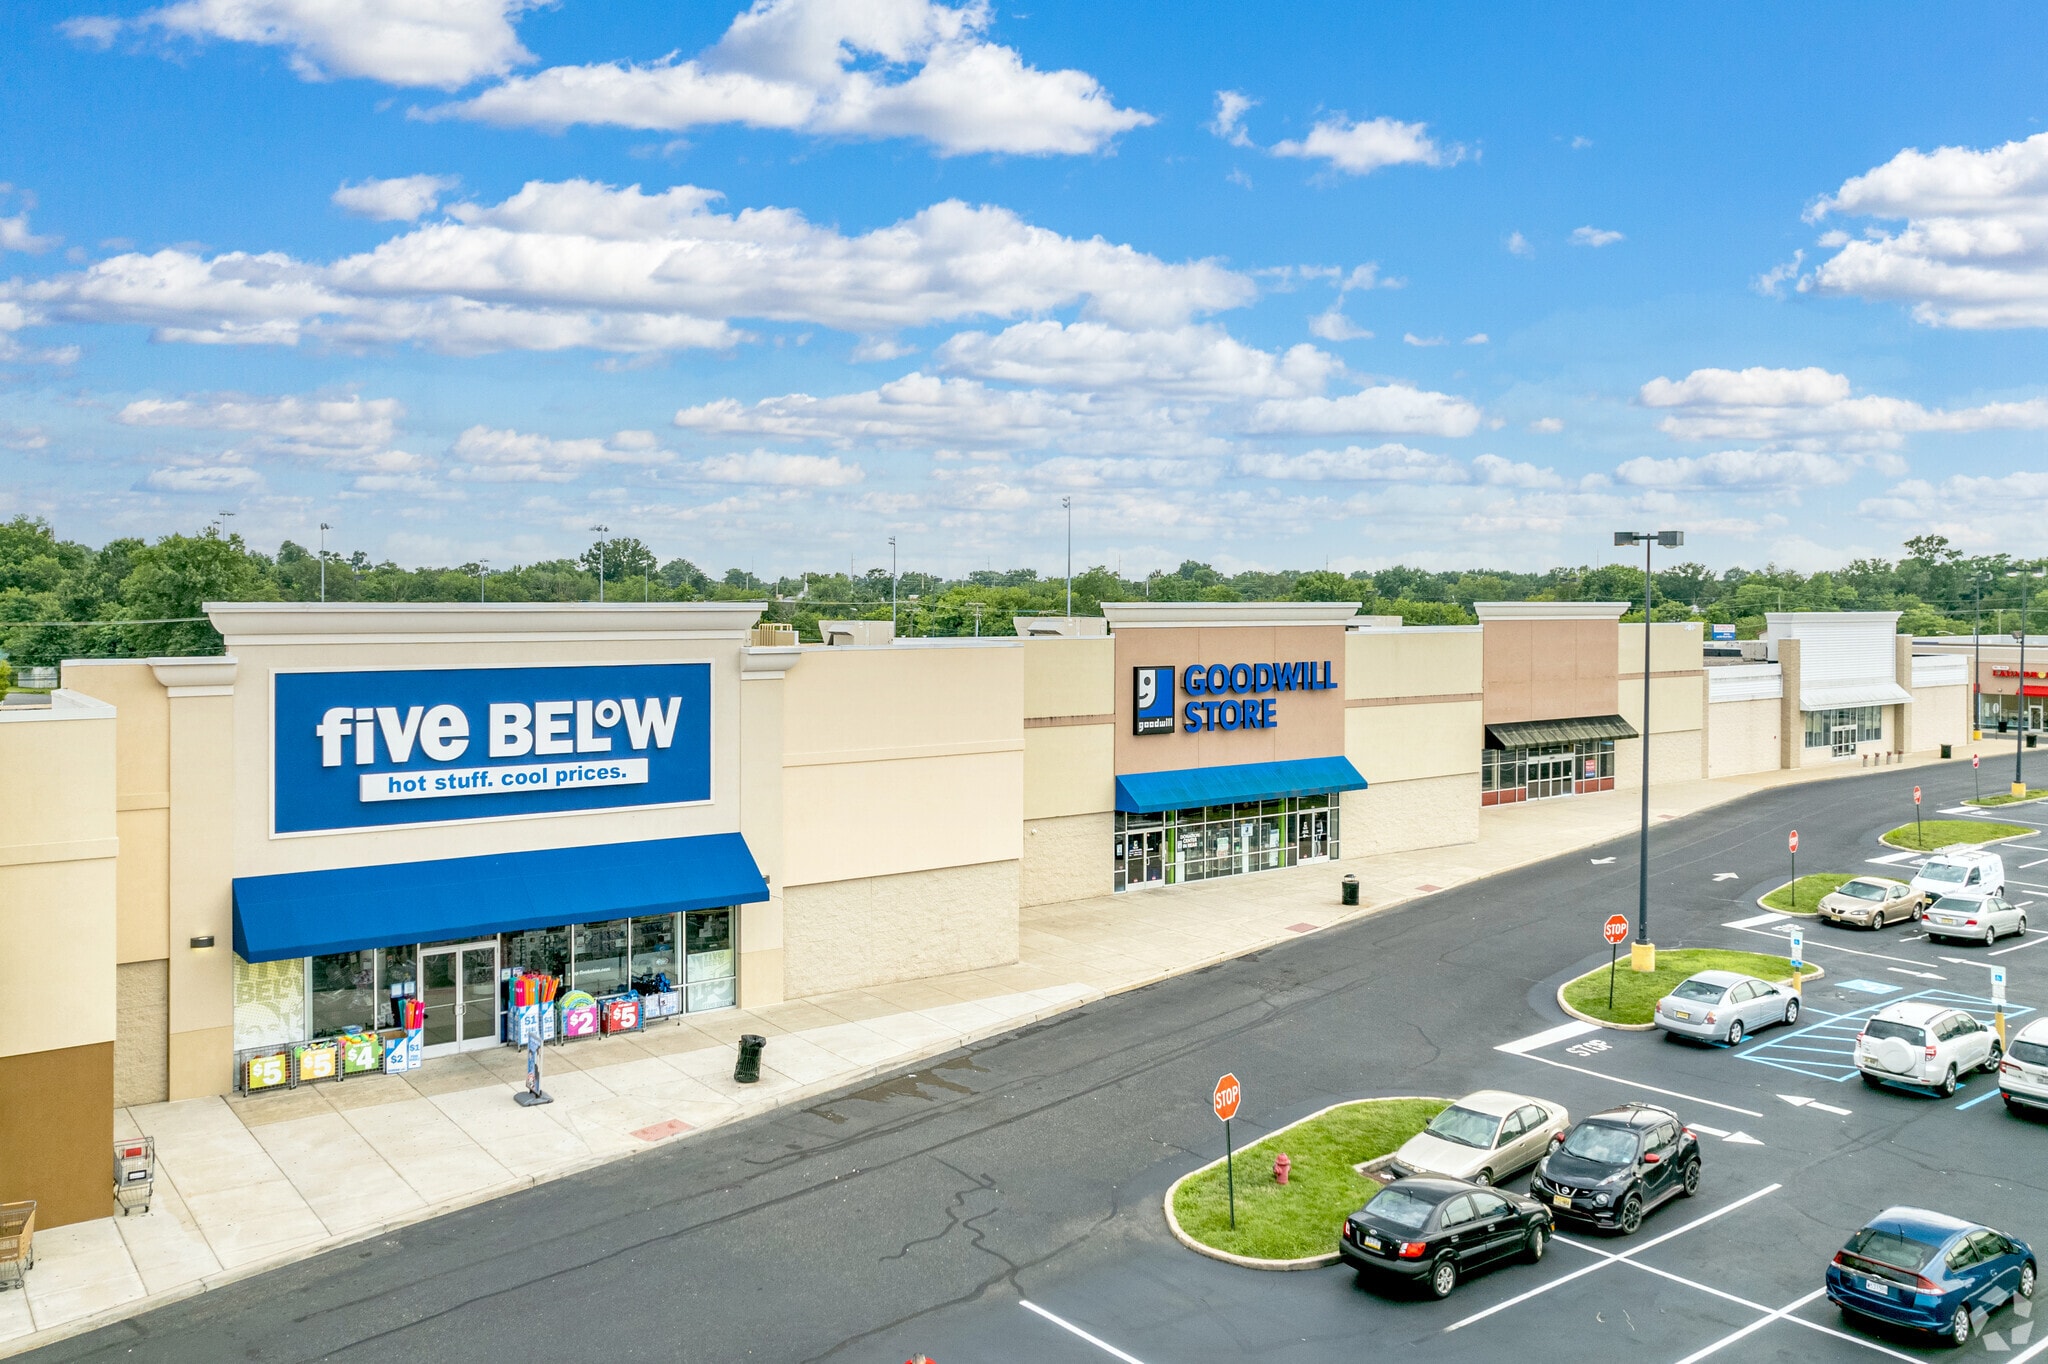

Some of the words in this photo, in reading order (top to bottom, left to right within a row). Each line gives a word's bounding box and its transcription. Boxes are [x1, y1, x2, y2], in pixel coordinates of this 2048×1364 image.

[1184, 660, 1338, 696] GOODWILL
[1138, 717, 1173, 732] goodwill
[1184, 698, 1278, 733] STORE
[489, 697, 683, 757] BELOW
[388, 775, 427, 793] hot
[434, 771, 493, 790] stuff.
[501, 768, 547, 786] cool
[556, 765, 627, 786] prices.
[1606, 923, 1627, 936] STOP
[524, 1014, 537, 1026] $1
[569, 1012, 594, 1034] $2
[613, 1007, 636, 1028] $5
[347, 1046, 375, 1069] $4
[409, 1044, 421, 1052] $1
[1565, 1039, 1613, 1056] STOP
[303, 1053, 332, 1077] $5
[390, 1054, 404, 1064] $2
[252, 1060, 282, 1085] $5
[1216, 1085, 1238, 1109] STOP
